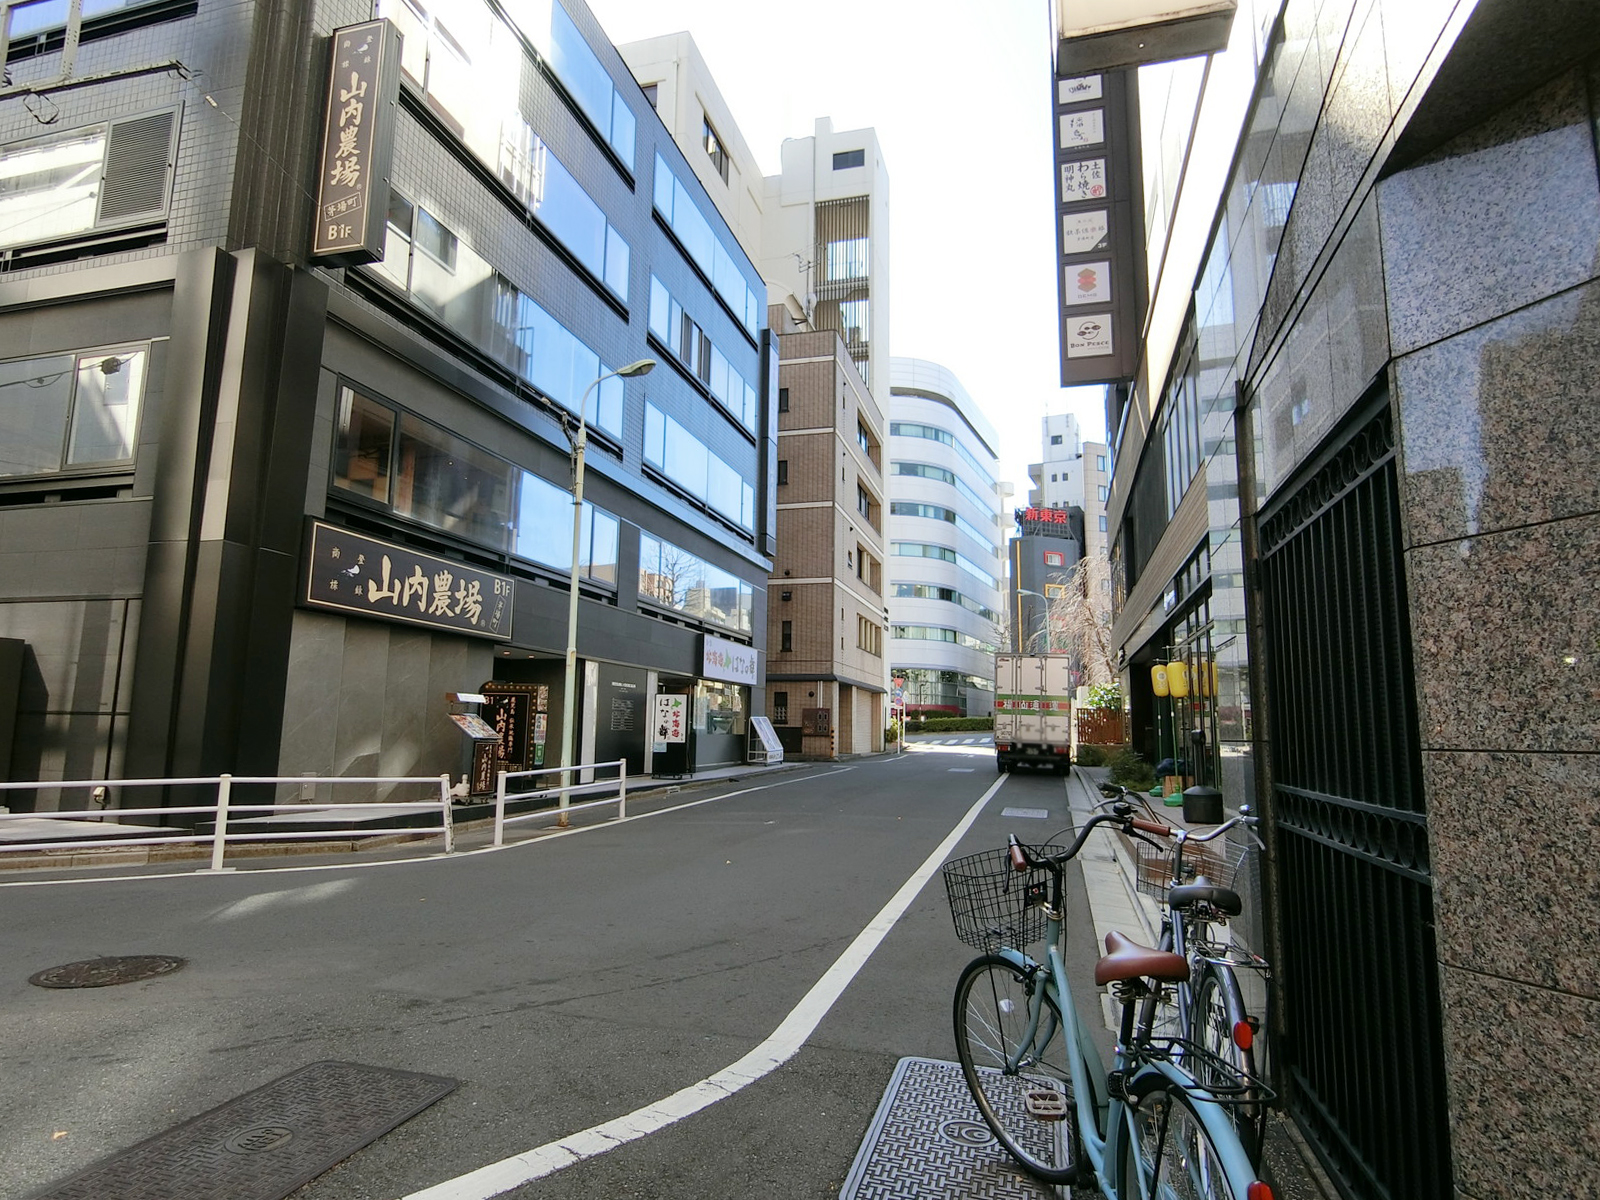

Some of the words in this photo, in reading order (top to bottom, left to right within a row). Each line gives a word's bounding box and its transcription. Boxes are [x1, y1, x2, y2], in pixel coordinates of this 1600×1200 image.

[330, 71, 367, 187] 山内農場
[1064, 165, 1075, 192] 明神丸
[1077, 162, 1090, 199] わら焼き
[1091, 161, 1101, 179] 土佐
[327, 196, 359, 217] 茅場町
[328, 223, 352, 241] B1F
[1025, 507, 1067, 524] 新東京
[367, 553, 484, 626] 山内農場
[494, 578, 511, 598] B1F
[705, 649, 724, 668] 北海道
[731, 653, 756, 680] はなの舞
[658, 697, 670, 741] はなの舞
[672, 709, 681, 738] 北海道
